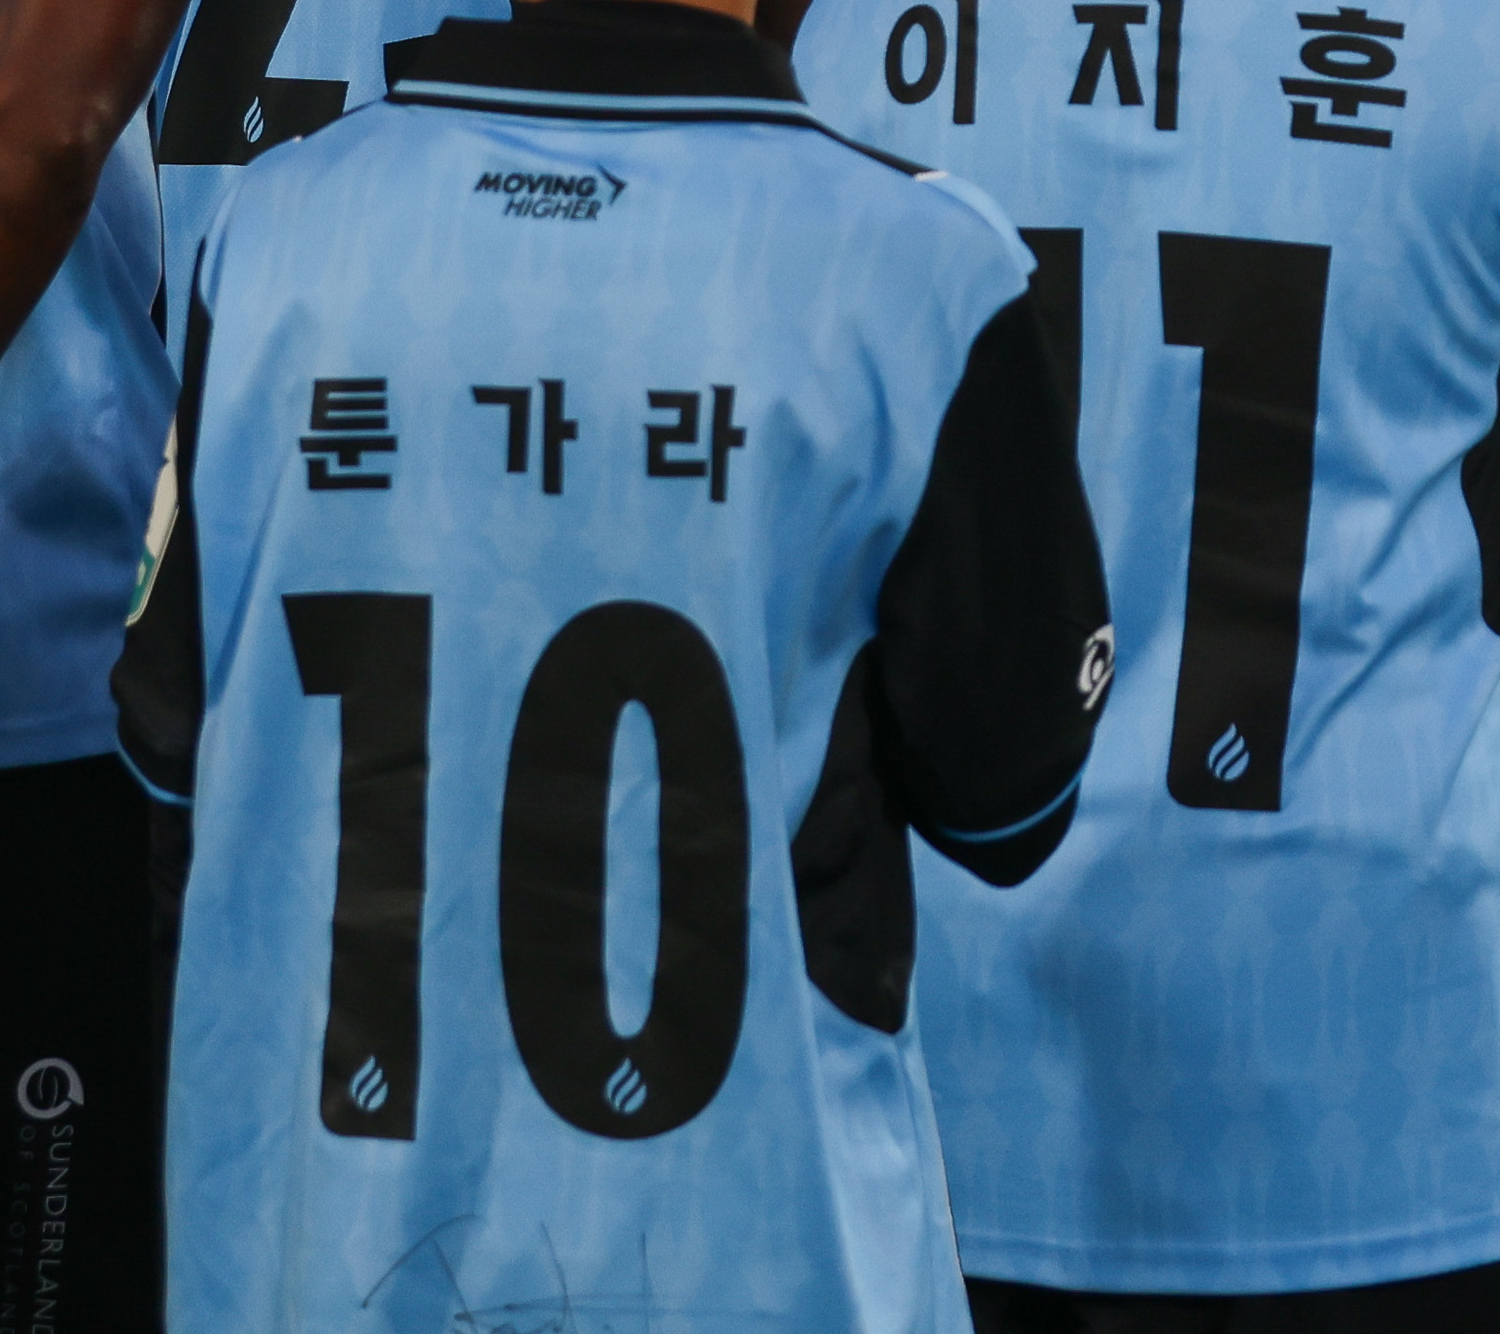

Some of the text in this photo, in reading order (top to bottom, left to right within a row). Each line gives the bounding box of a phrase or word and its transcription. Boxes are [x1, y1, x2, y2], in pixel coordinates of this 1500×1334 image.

[474, 171, 598, 197] MOVING
[503, 196, 603, 222] HIGHER
[280, 588, 750, 1143] 10
